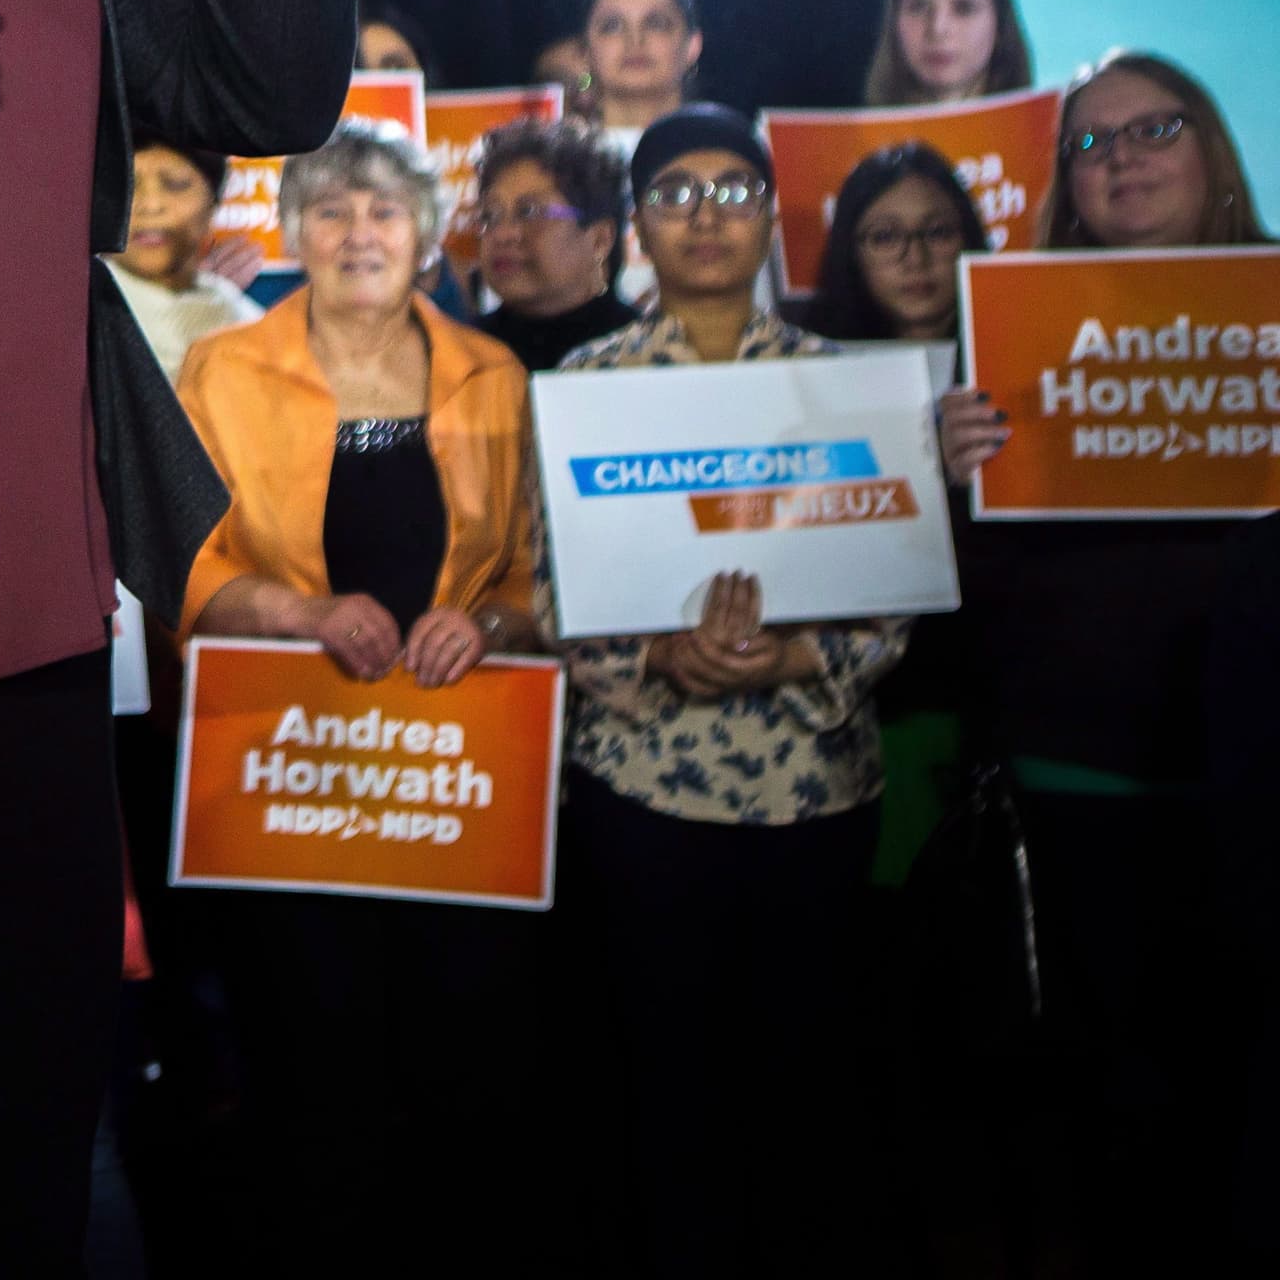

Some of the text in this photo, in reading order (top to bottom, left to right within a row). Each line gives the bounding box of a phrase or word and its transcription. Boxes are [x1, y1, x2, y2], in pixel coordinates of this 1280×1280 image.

[1069, 315, 1280, 363] Andrea
[1041, 367, 1280, 414] Horwat
[1073, 423, 1166, 458] NDP
[593, 446, 831, 491] CHANGEONS
[271, 704, 465, 758] Andrea
[242, 748, 493, 808] Horwath
[263, 803, 463, 845] NDP NPD
